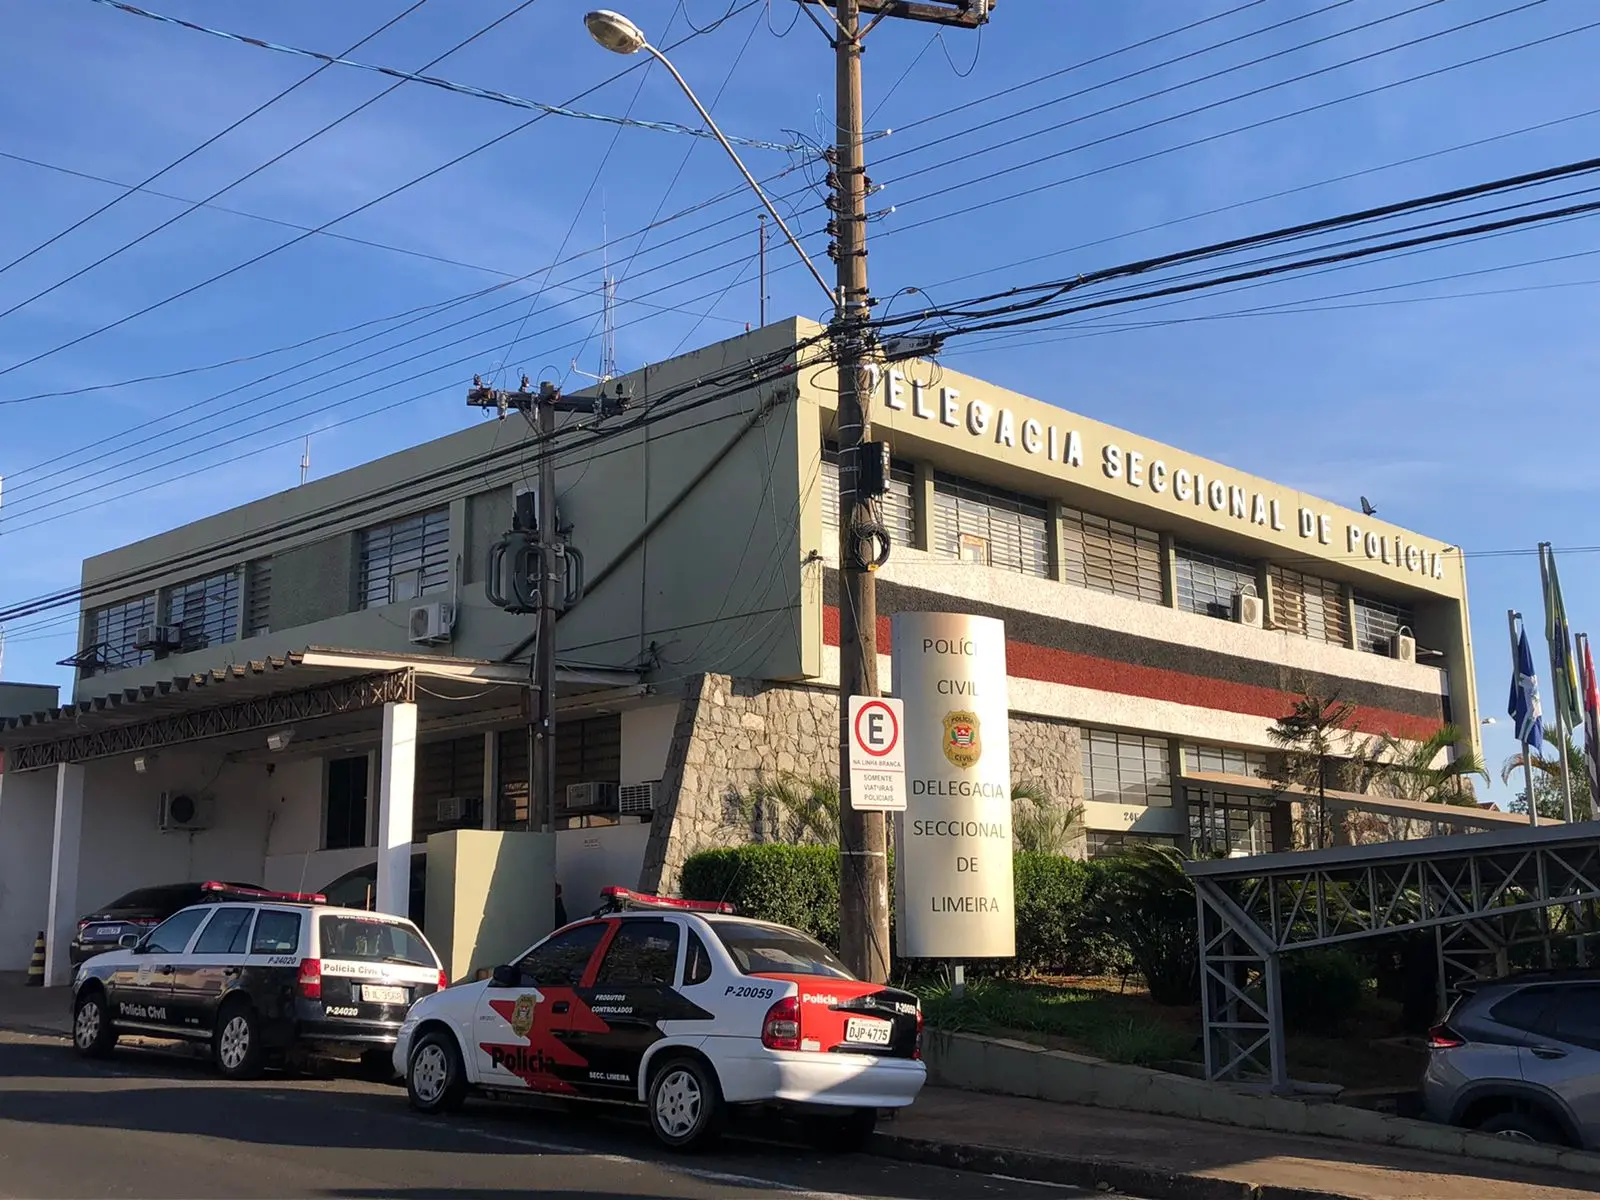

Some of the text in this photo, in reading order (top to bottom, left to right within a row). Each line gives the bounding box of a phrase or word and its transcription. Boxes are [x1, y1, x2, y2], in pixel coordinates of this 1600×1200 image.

[1102, 444, 1286, 531] SECCIONAL
[1299, 507, 1332, 544] DE
[1347, 524, 1444, 579] POLÍCIA
[923, 638, 977, 656] POLÍCI
[937, 679, 979, 696] CIVIL
[868, 713, 884, 744] E
[864, 774, 893, 782] SOMENTE
[864, 784, 893, 792] VIATURAS
[913, 780, 1004, 798] DELEGACIA
[864, 794, 894, 802] POLICIAIS
[913, 820, 1005, 839] SECCIONAL
[957, 856, 978, 872] DE
[932, 896, 999, 912] LIMEIRA
[267, 956, 297, 964] P-24020
[724, 985, 774, 999] P-20059
[802, 993, 838, 1005] Polícia
[147, 1006, 166, 1019] Civil
[326, 1006, 359, 1016] P-24020
[589, 1071, 630, 1081] SECC. LIMEIRA
